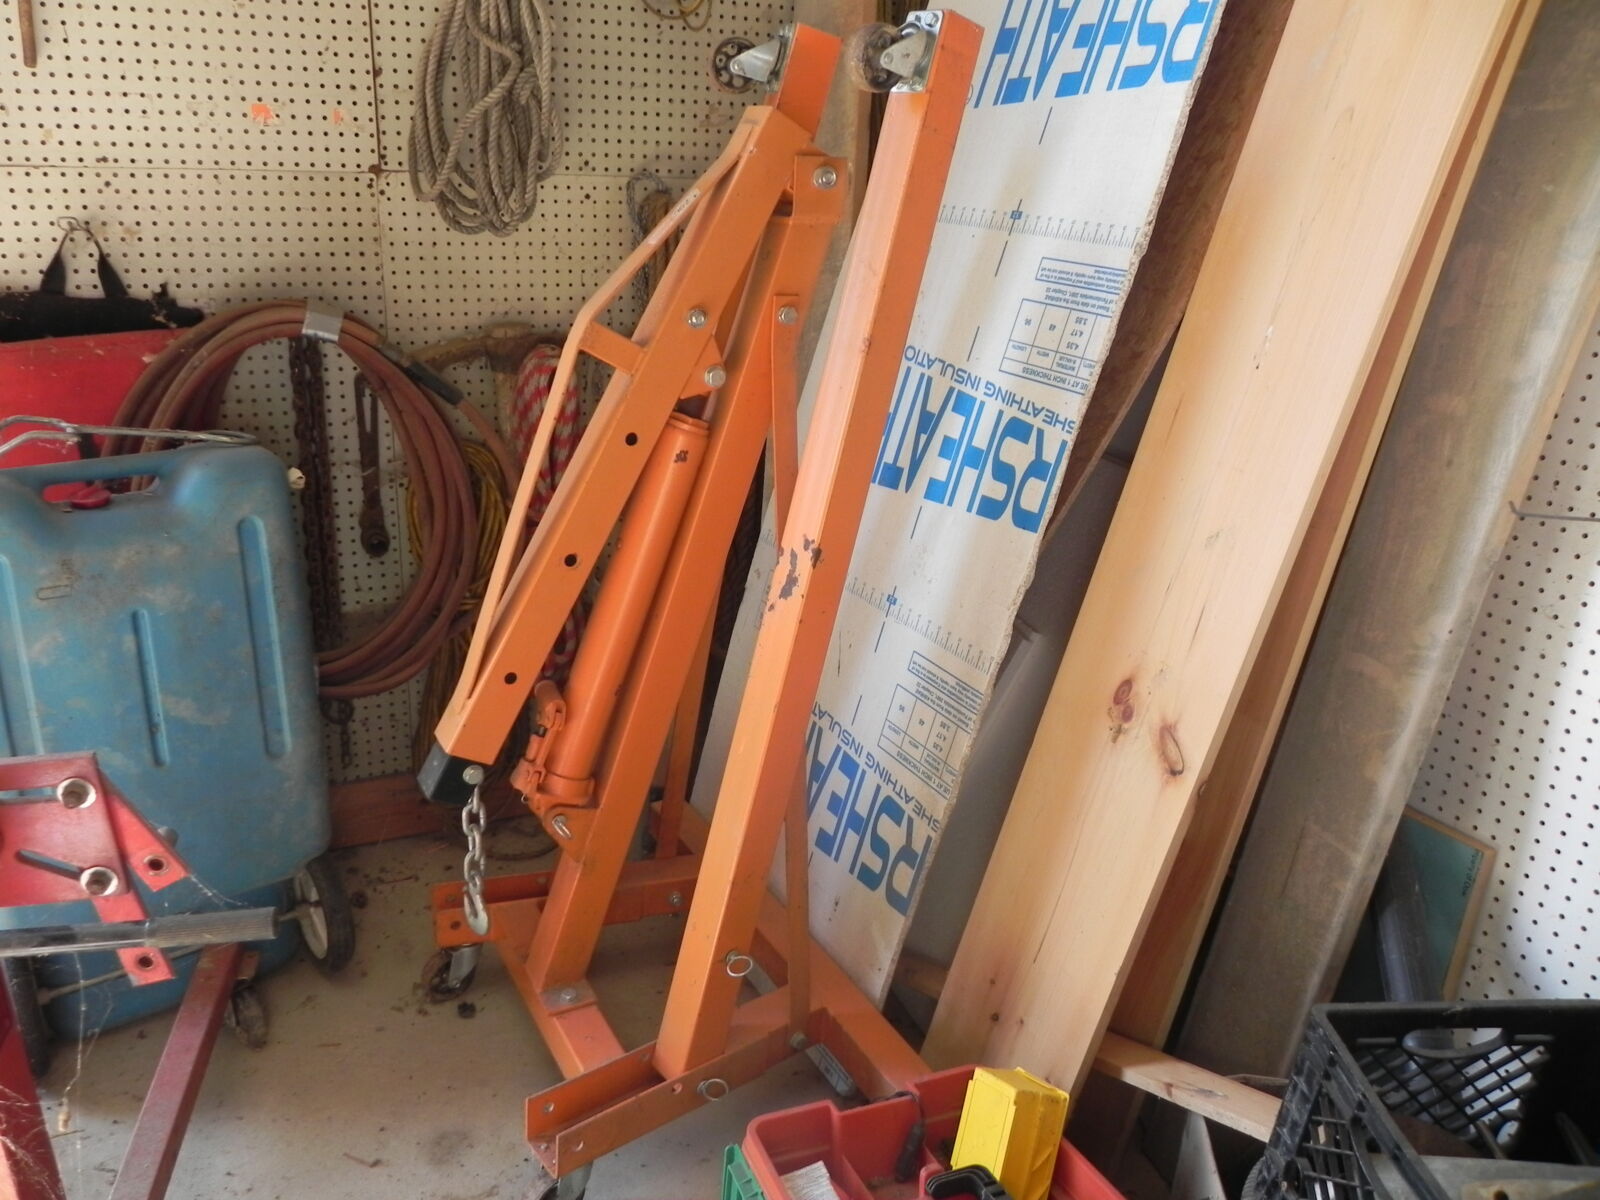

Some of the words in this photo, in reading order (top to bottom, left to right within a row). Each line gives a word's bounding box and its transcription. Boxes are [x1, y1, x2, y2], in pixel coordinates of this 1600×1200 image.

[1070, 328, 1084, 338] 4.17
[904, 345, 980, 392] INSULATIO
[1022, 367, 1053, 382] THICKNESS
[983, 382, 1076, 434] SHEATHING
[865, 748, 941, 833] SHEATHING
